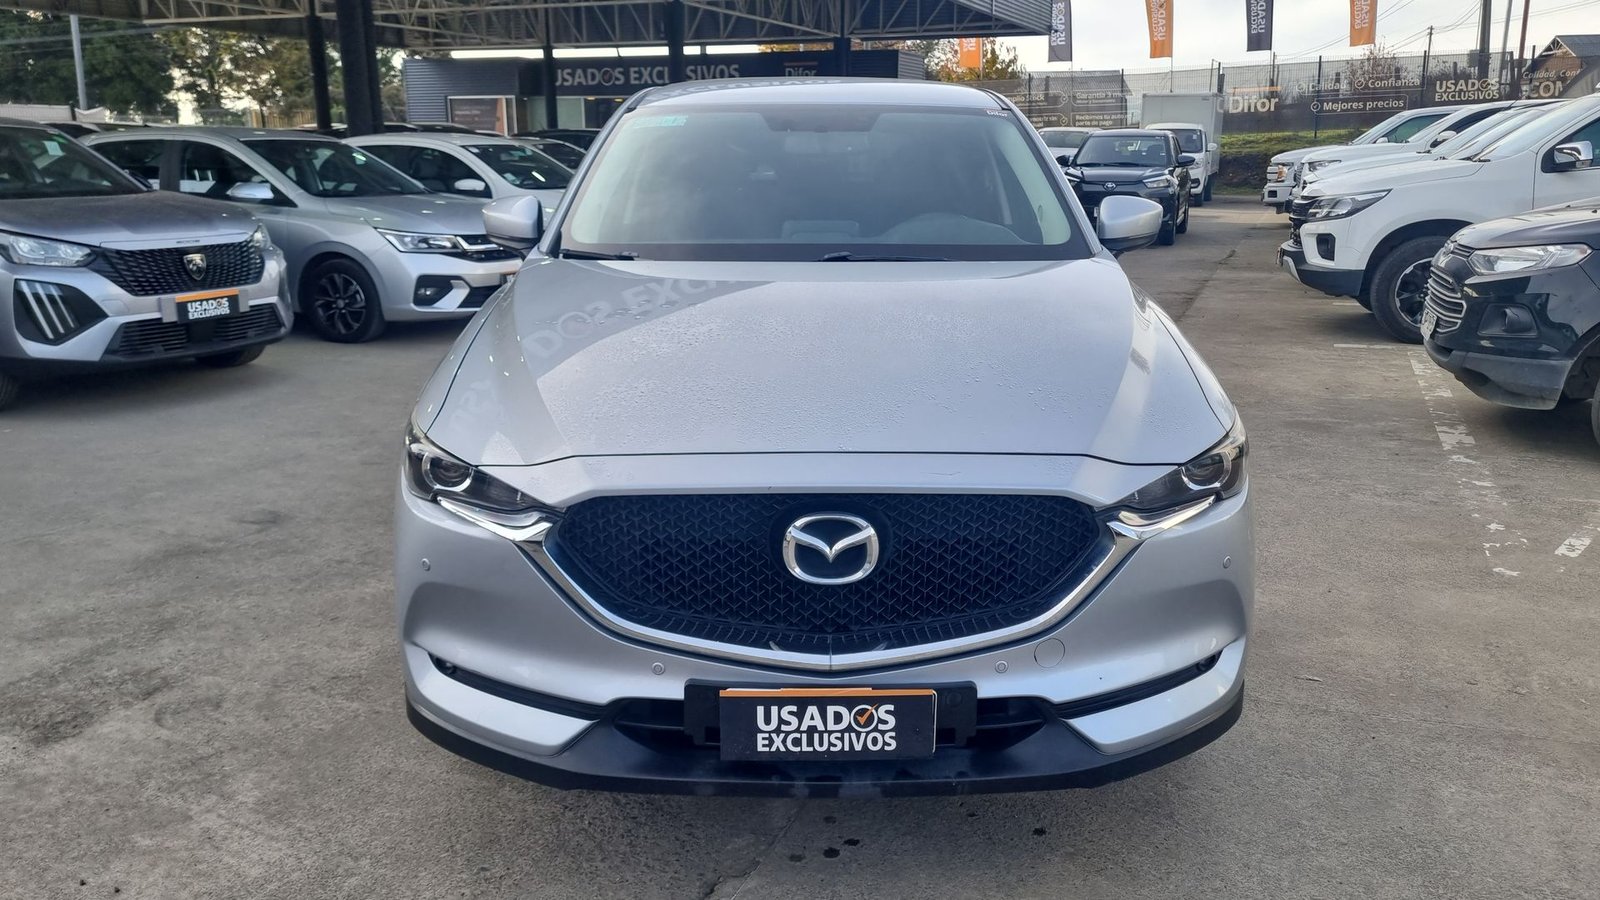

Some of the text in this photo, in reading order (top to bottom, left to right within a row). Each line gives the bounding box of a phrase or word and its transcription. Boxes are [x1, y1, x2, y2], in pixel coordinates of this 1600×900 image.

[1368, 78, 1420, 88] Confianza
[1435, 78, 1499, 93] USADOS
[1435, 90, 1499, 101] EXCLUSIVOS
[1229, 96, 1279, 113] Difor
[1323, 97, 1404, 111] Mejores precios
[187, 297, 230, 312] USADOS
[188, 307, 231, 320] EXCLUSIVOS
[756, 704, 897, 732] USADOS
[756, 732, 898, 752] EXCLUSIVOS
